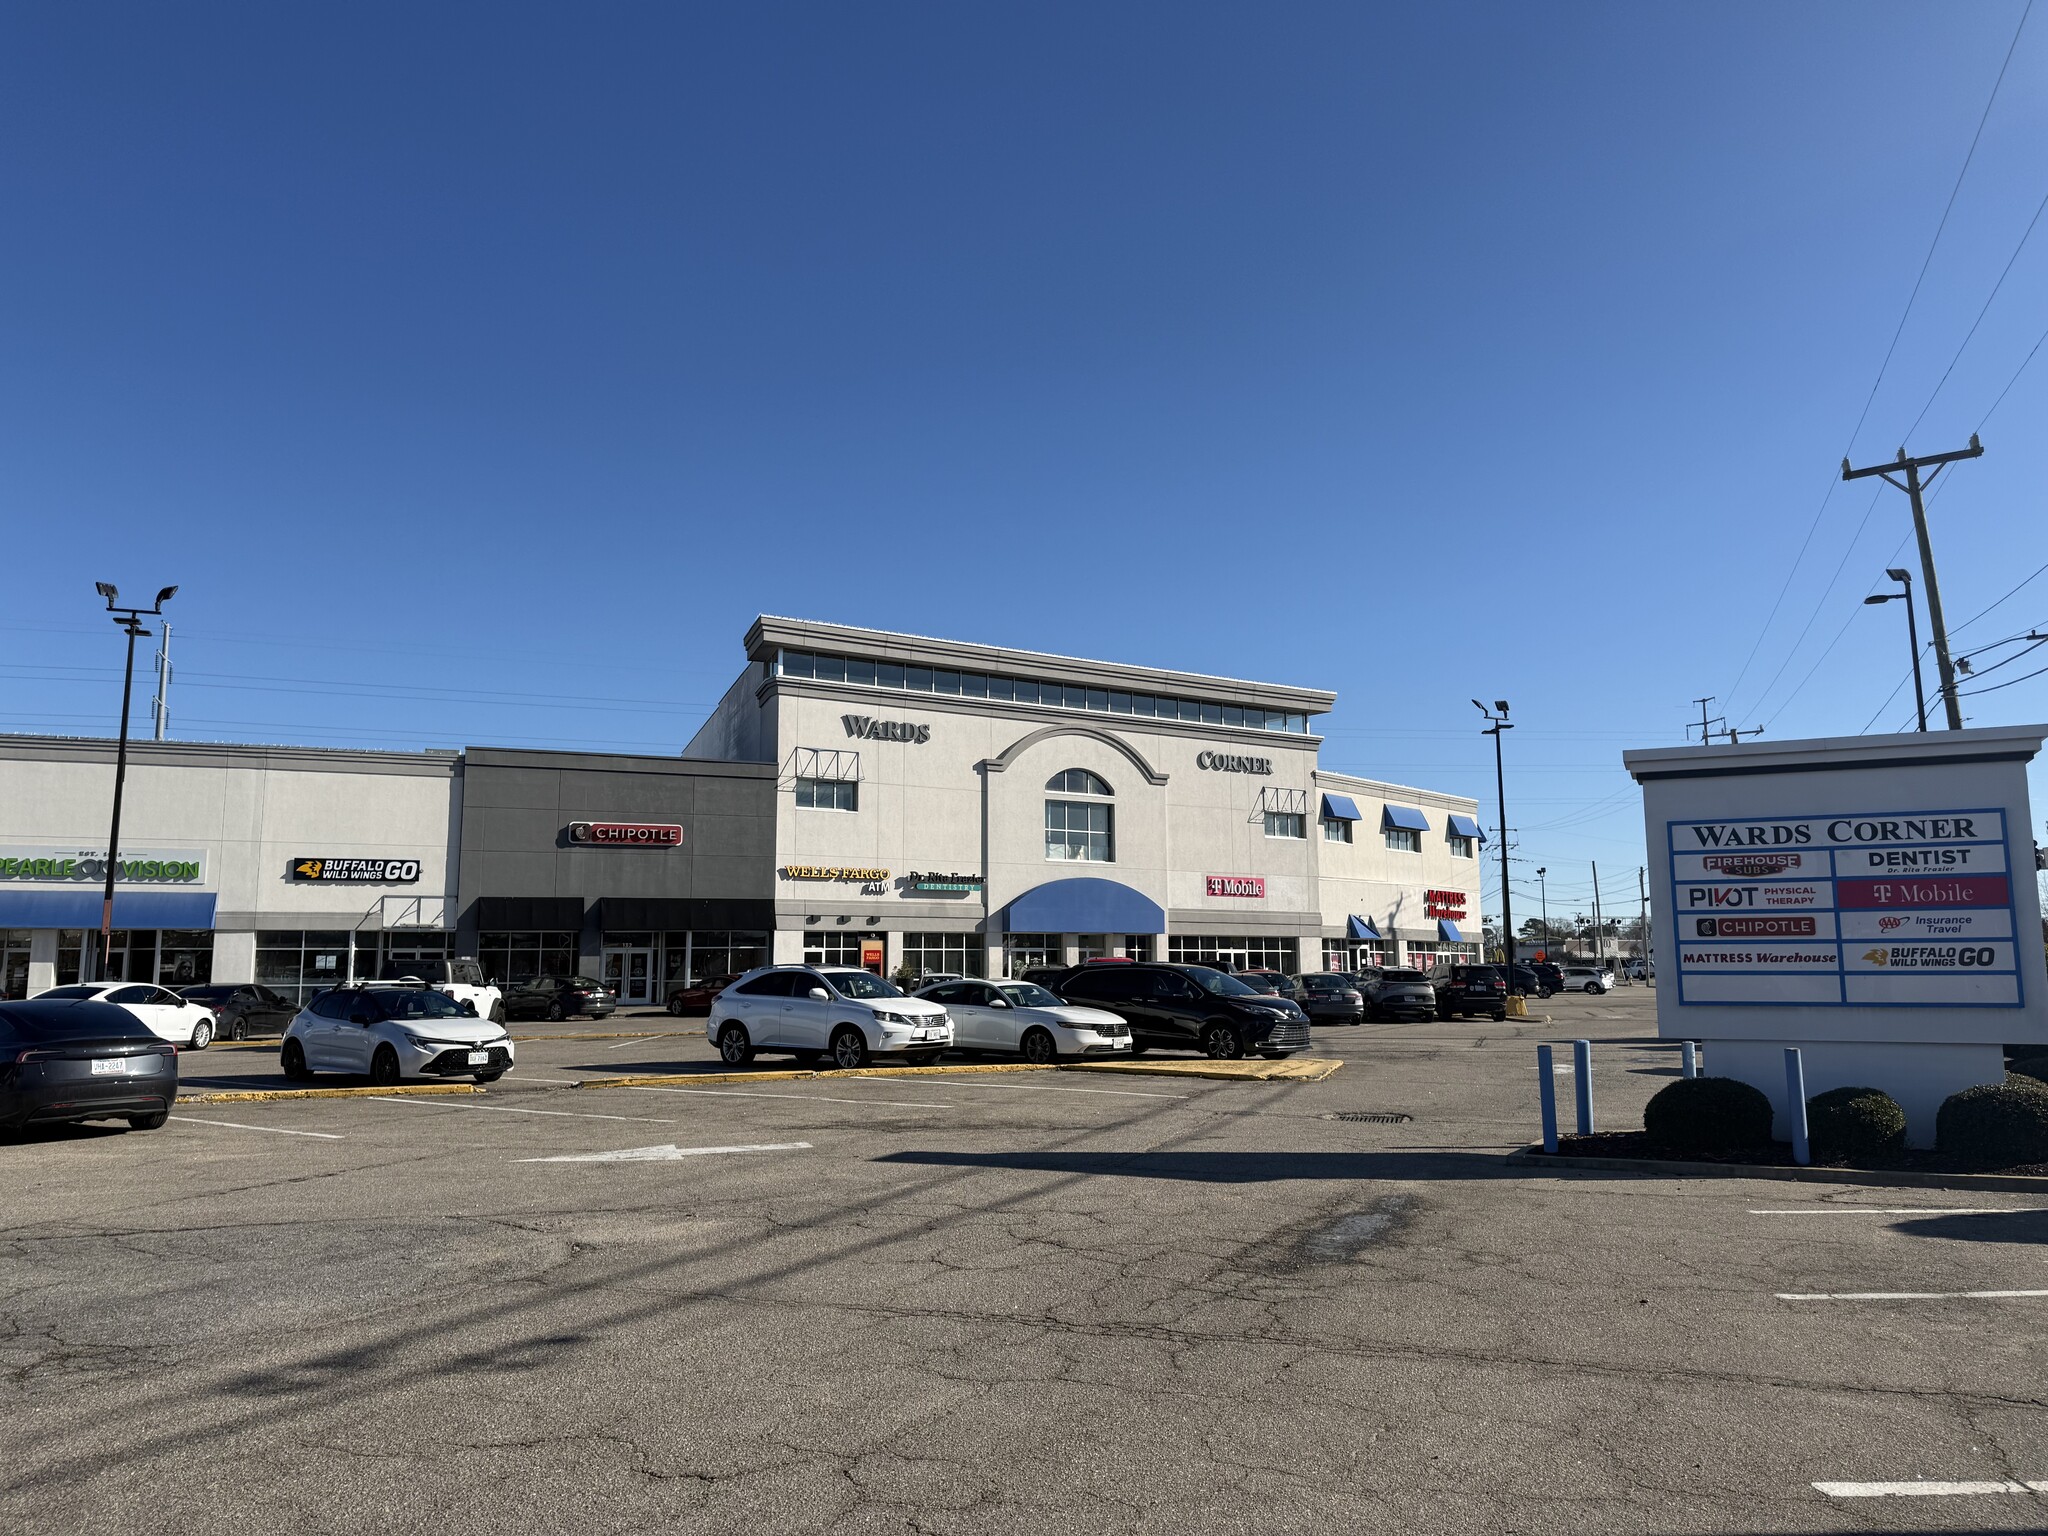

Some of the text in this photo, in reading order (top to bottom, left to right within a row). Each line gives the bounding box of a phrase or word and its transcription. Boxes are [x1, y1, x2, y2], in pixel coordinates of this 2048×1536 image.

[843, 714, 930, 743] WARDS
[1199, 750, 1274, 774] CORNER
[596, 828, 677, 840] CHIPOTLE
[1692, 818, 1978, 847] WARDS CORNER
[1706, 856, 1798, 871] FIREHOUSE
[1869, 849, 1971, 867] DENTIST
[121, 860, 199, 878] VISION
[322, 871, 382, 879] WILD WINGS
[324, 860, 418, 880] BUFFALO GO
[785, 865, 890, 880] WELLS FARGO
[1735, 866, 1769, 874] SUBS
[868, 882, 890, 891] ATM
[923, 883, 975, 891] DENTISTRY
[1223, 879, 1263, 895] Mobile
[1764, 887, 1816, 895] PHYSICAL
[1900, 883, 1975, 903] Mobile
[1428, 889, 1466, 905] MATTRESS
[1689, 887, 1759, 907] PIVOT
[1766, 897, 1815, 905] THERAPY
[1722, 920, 1811, 933] CHIPOTLE
[1915, 916, 1972, 925] Insurance
[1926, 925, 1961, 933] Travel
[1683, 952, 1837, 963] MATTRESS Warehouse
[1890, 958, 1956, 967] WILD WINGS
[1891, 947, 1995, 966] BUFFALO GO
